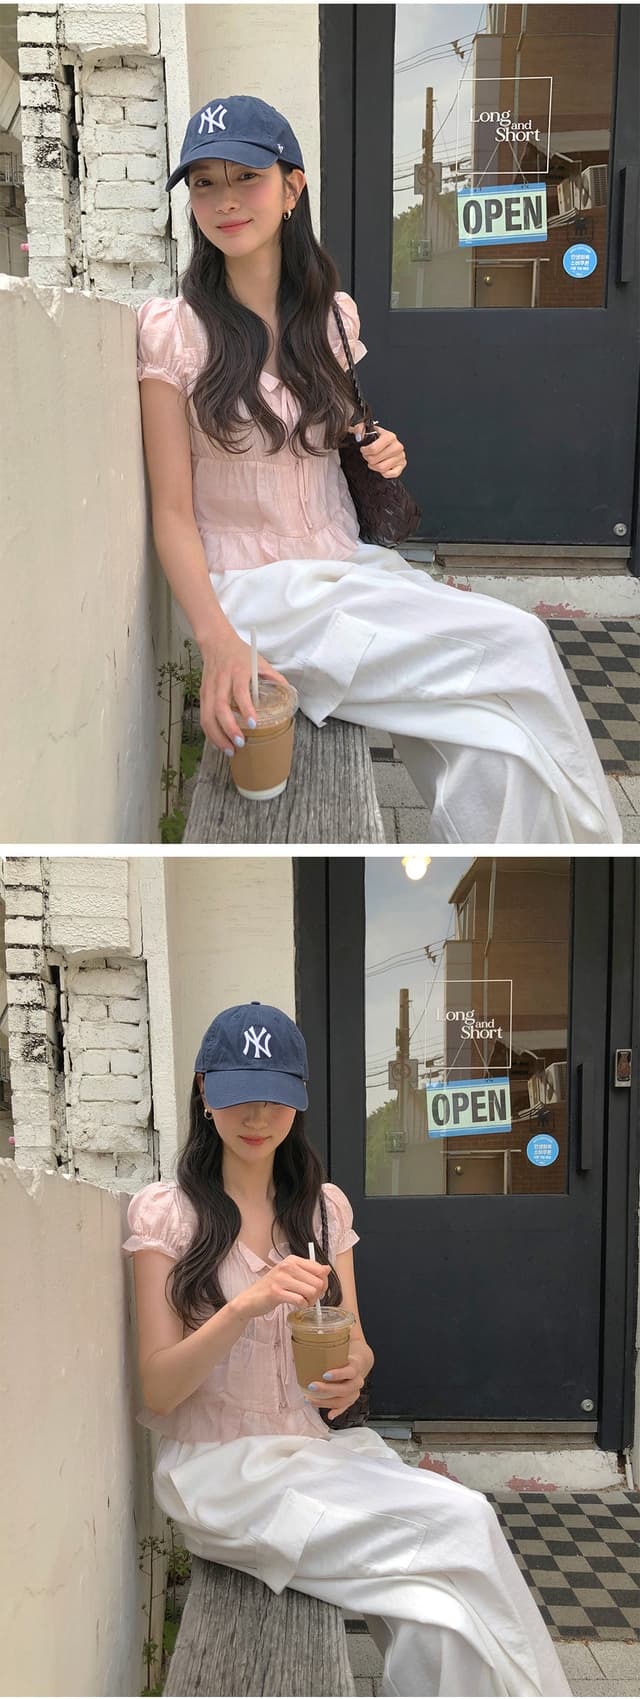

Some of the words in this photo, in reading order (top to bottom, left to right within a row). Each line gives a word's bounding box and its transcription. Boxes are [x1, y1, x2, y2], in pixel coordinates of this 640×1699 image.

[198, 104, 227, 134] NY
[470, 108, 511, 127] Long
[511, 119, 532, 130] and
[495, 127, 540, 142] Short
[463, 195, 543, 234] OPEN
[436, 1007, 475, 1025] Long
[475, 1018, 495, 1028] and
[461, 1025, 503, 1039] Short
[242, 1025, 272, 1058] NY
[431, 1088, 507, 1126] OPEN
